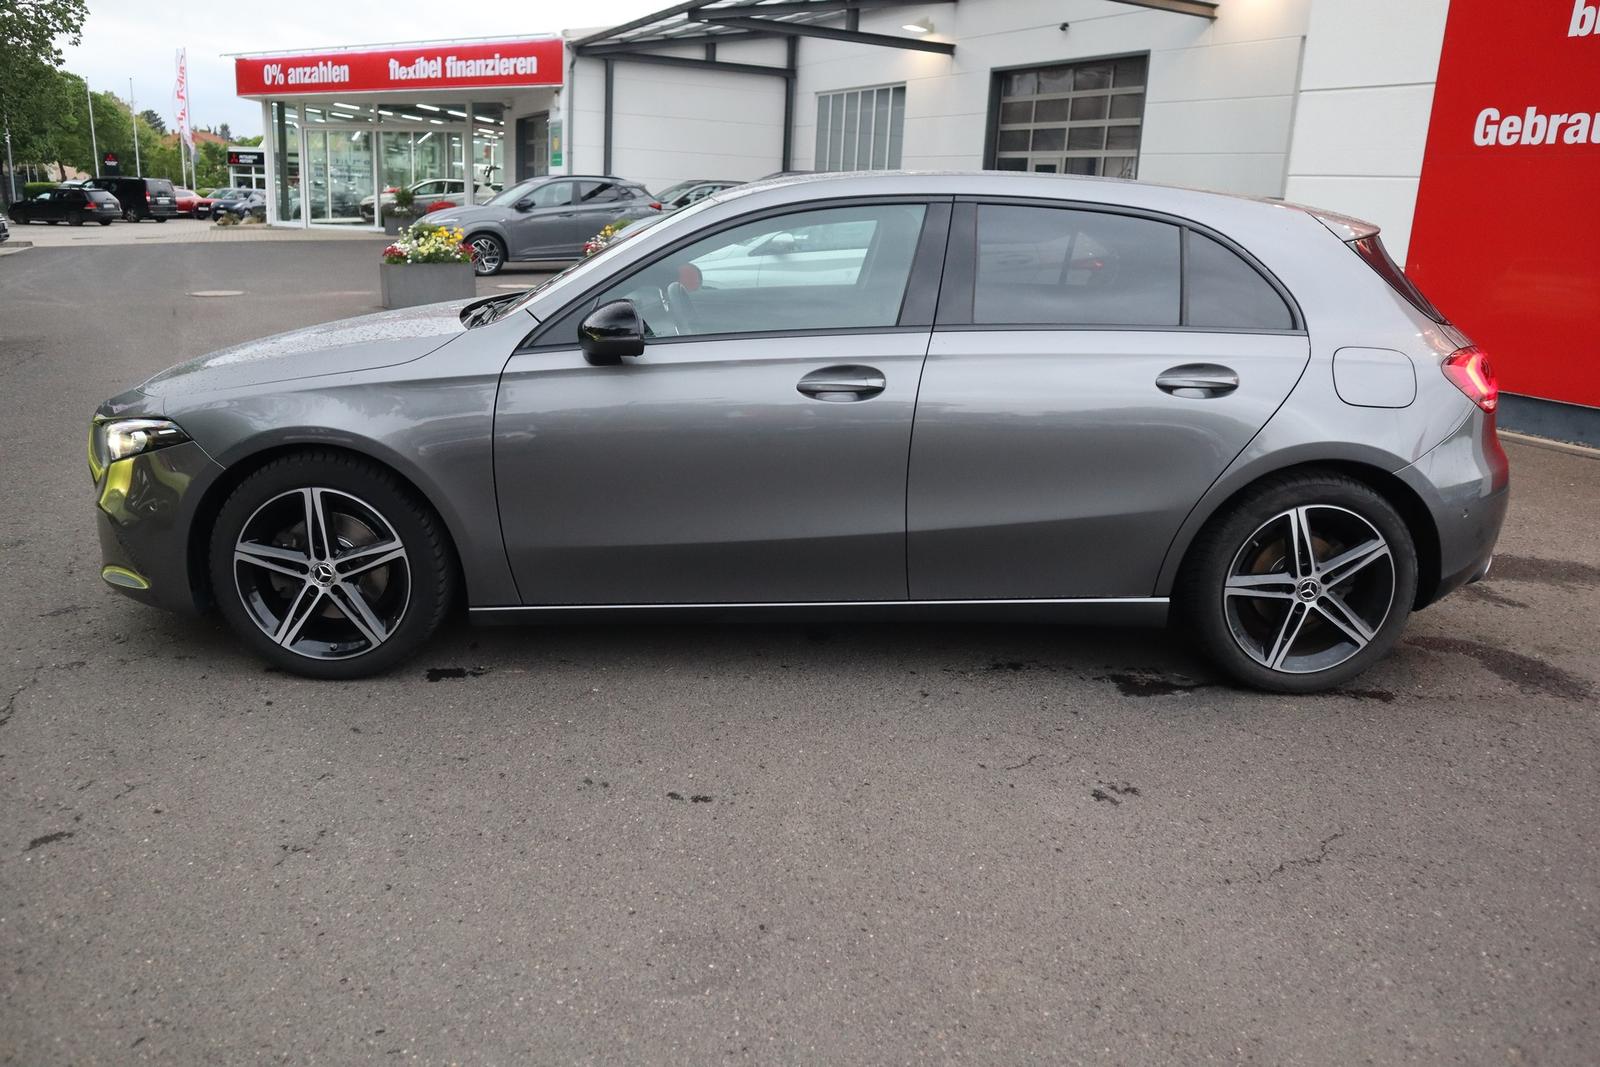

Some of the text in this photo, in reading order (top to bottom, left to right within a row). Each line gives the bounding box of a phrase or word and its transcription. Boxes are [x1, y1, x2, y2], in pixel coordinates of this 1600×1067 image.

[263, 61, 350, 85] 0% anzahlen
[388, 53, 538, 80] flexibel finanzieren
